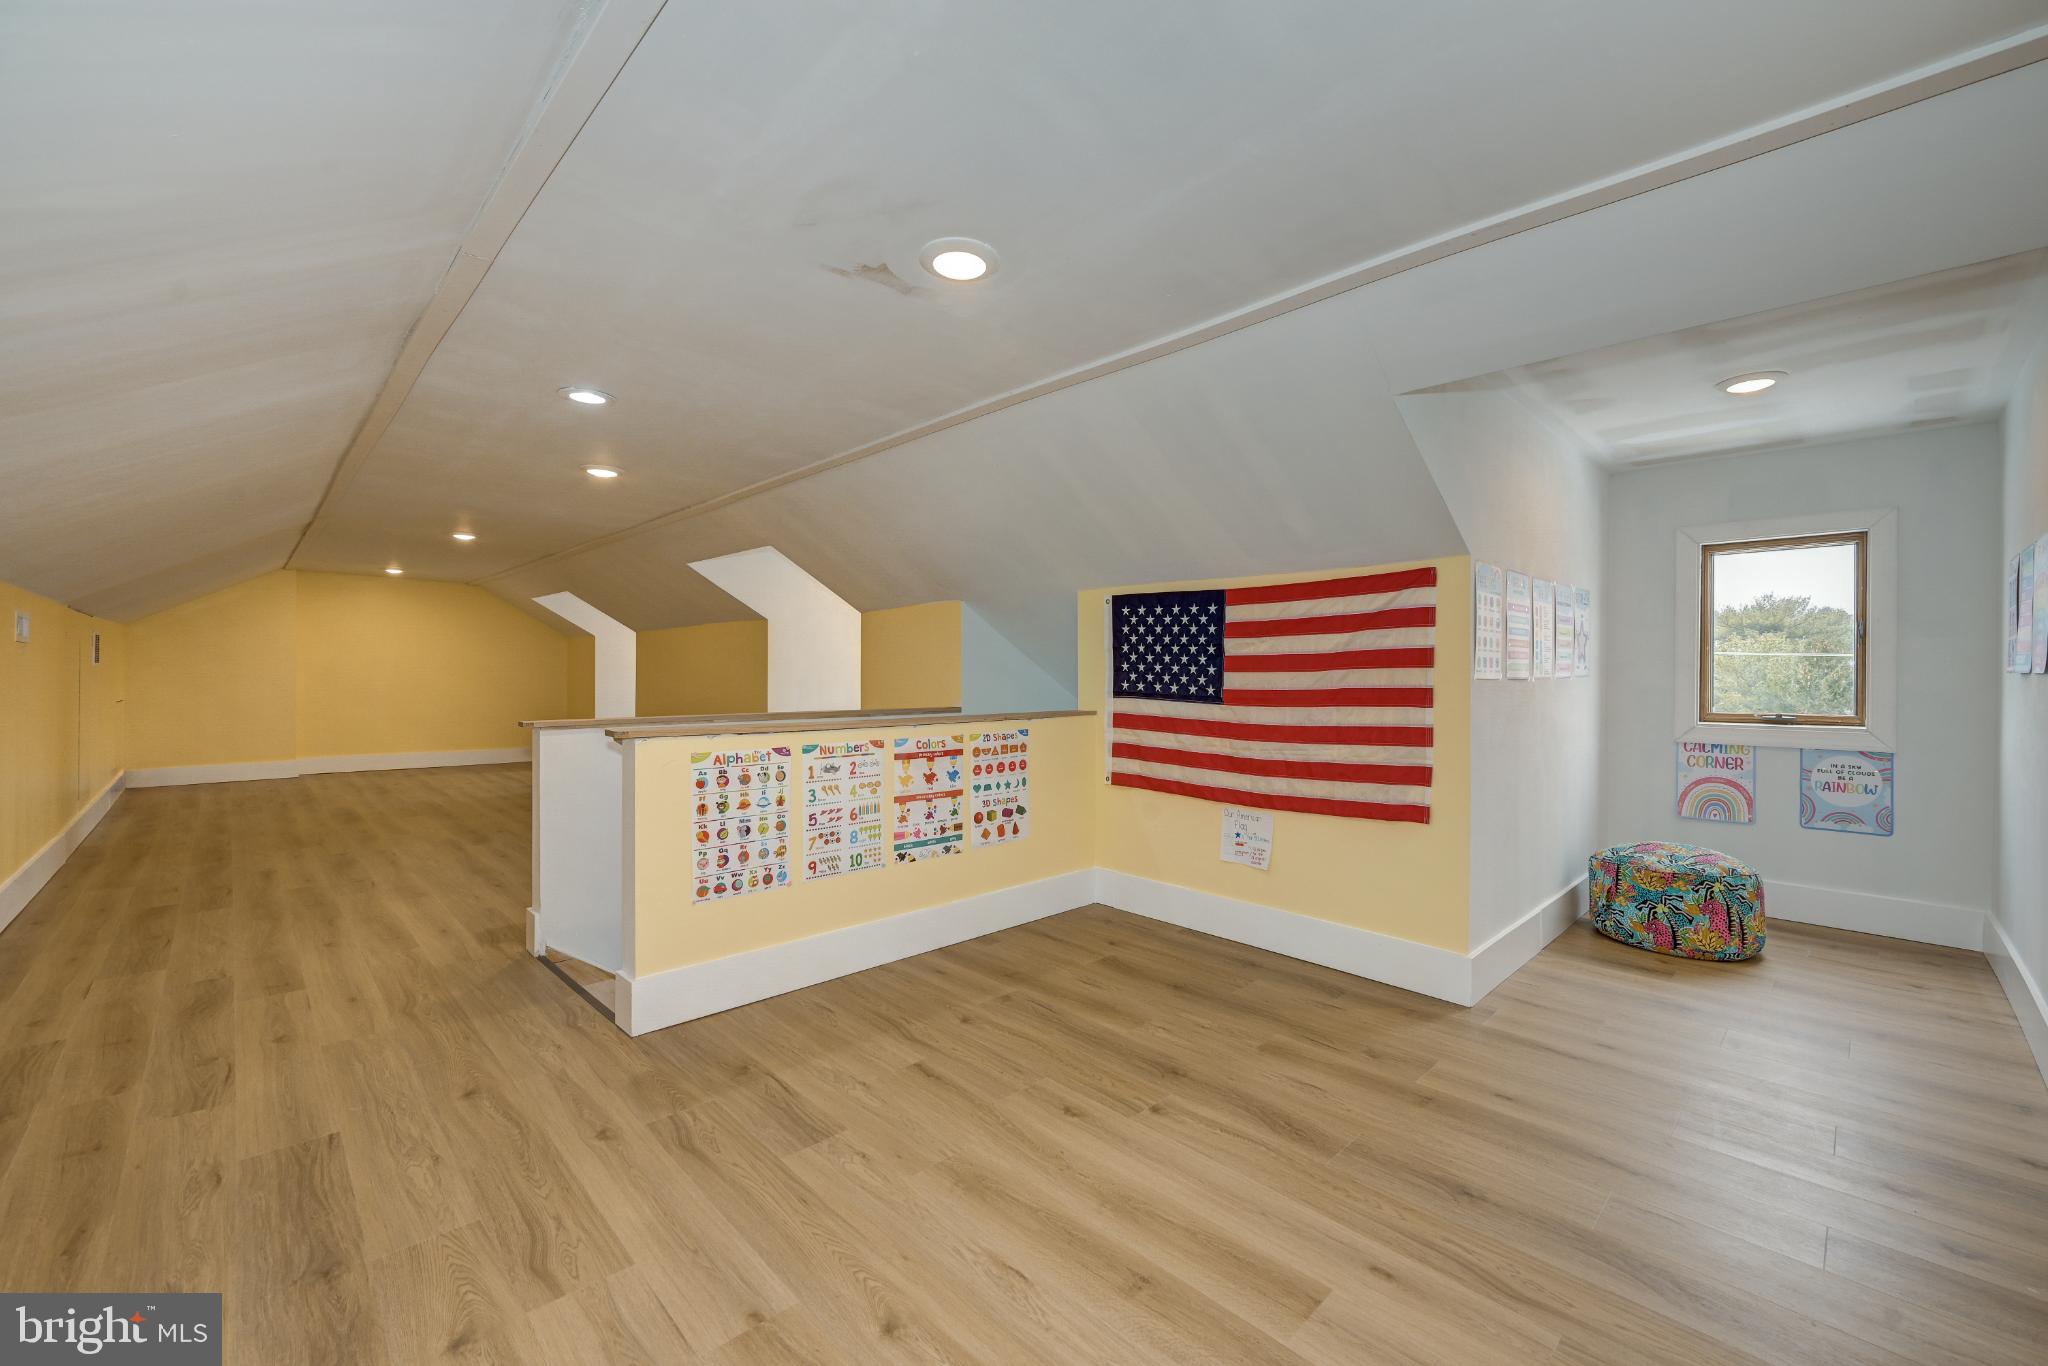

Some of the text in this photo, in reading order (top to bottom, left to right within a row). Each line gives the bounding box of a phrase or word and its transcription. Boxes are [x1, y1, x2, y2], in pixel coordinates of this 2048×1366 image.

[916, 739, 946, 749] Colors
[993, 733, 1018, 741] Shapes
[820, 743, 870, 755] Numbers
[1683, 742, 1750, 755] CALMING
[713, 751, 772, 767] Alphabet
[1686, 755, 1744, 770] CORNER
[808, 766, 815, 779] 1
[850, 761, 857, 775] 2
[850, 784, 858, 799] 4
[1815, 781, 1878, 795] RAINBOW
[808, 788, 816, 803] 3
[982, 796, 1018, 808] 3D Shapes
[808, 813, 817, 826] 5
[850, 807, 858, 821] 6
[808, 836, 817, 851] 7
[850, 830, 858, 844] 8
[849, 853, 863, 868] 10
[808, 861, 817, 875] 9
